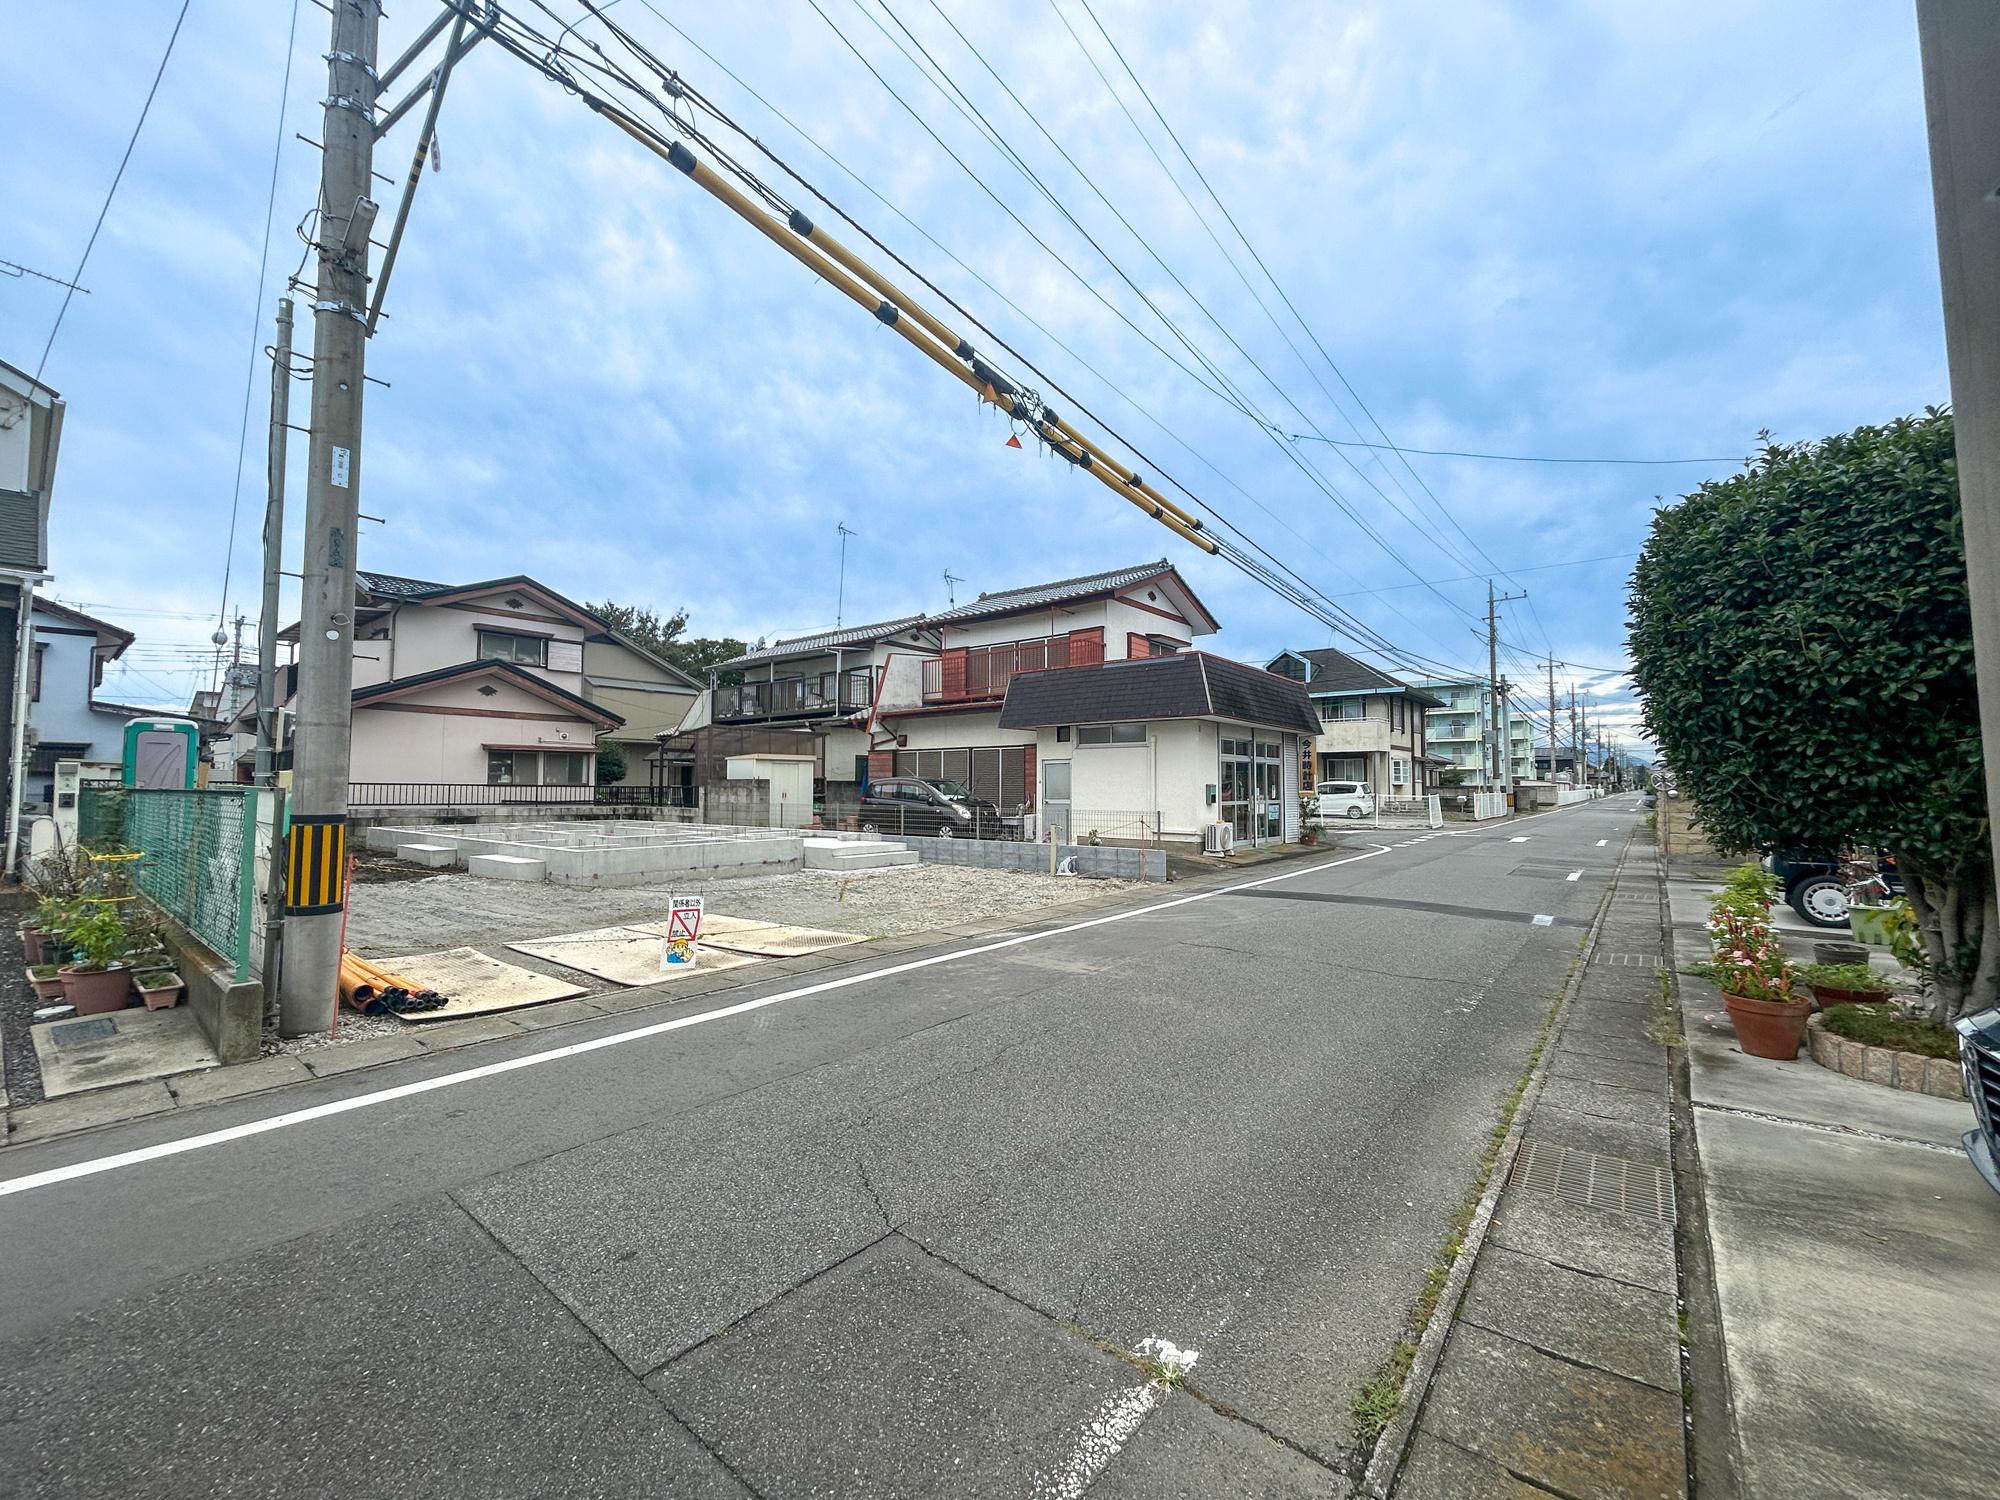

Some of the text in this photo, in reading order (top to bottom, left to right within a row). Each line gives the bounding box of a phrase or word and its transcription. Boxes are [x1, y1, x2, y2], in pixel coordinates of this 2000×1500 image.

[1302, 739, 1312, 791] 今井時計店
[673, 899, 701, 908] 関係者以外
[683, 912, 696, 920] 立入
